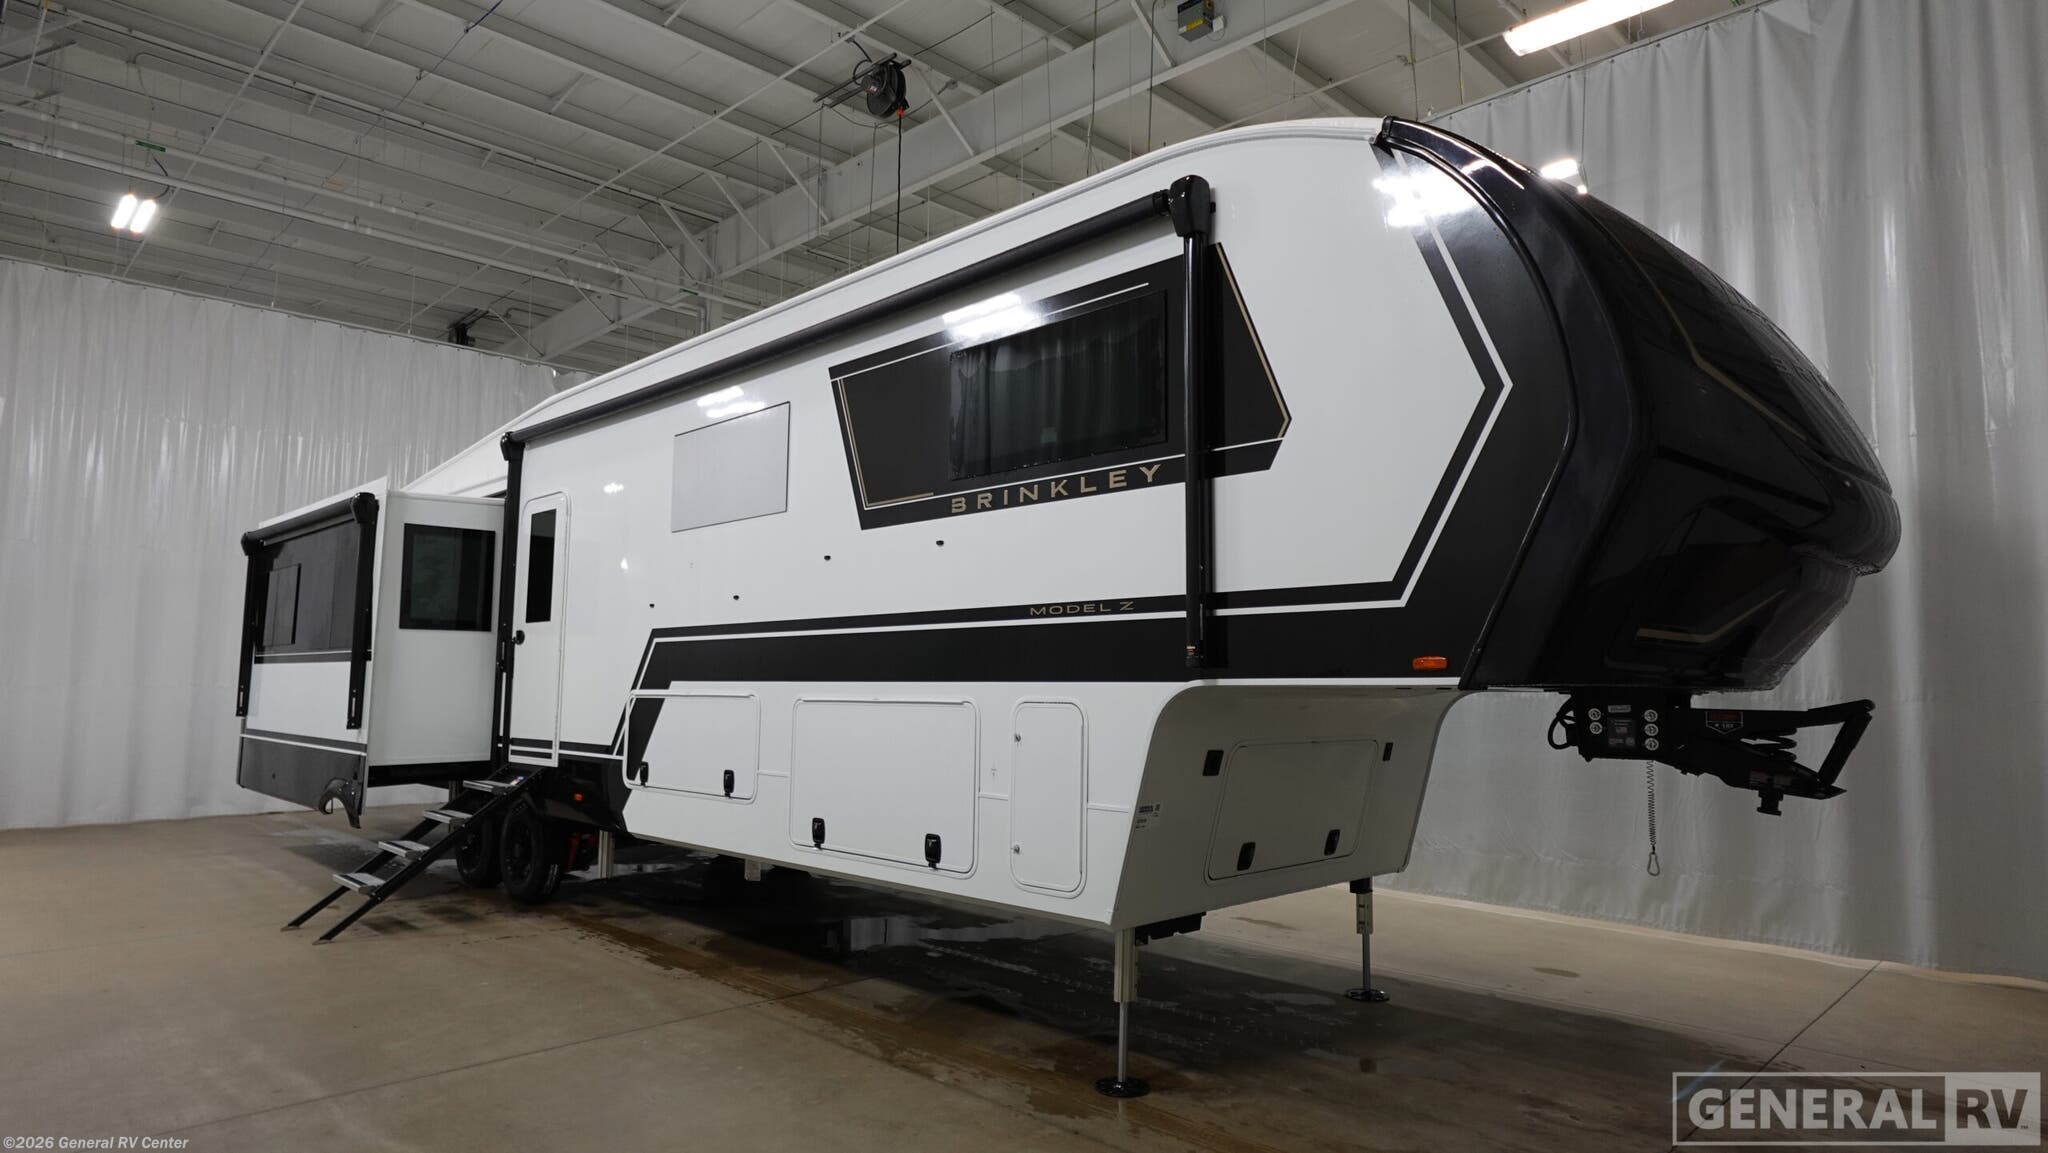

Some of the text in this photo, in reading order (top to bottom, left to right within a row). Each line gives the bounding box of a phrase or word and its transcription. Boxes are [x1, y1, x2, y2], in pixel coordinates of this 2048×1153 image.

[951, 464, 1162, 513] BRINKLEY
[1030, 601, 1135, 616] MODEL Z
